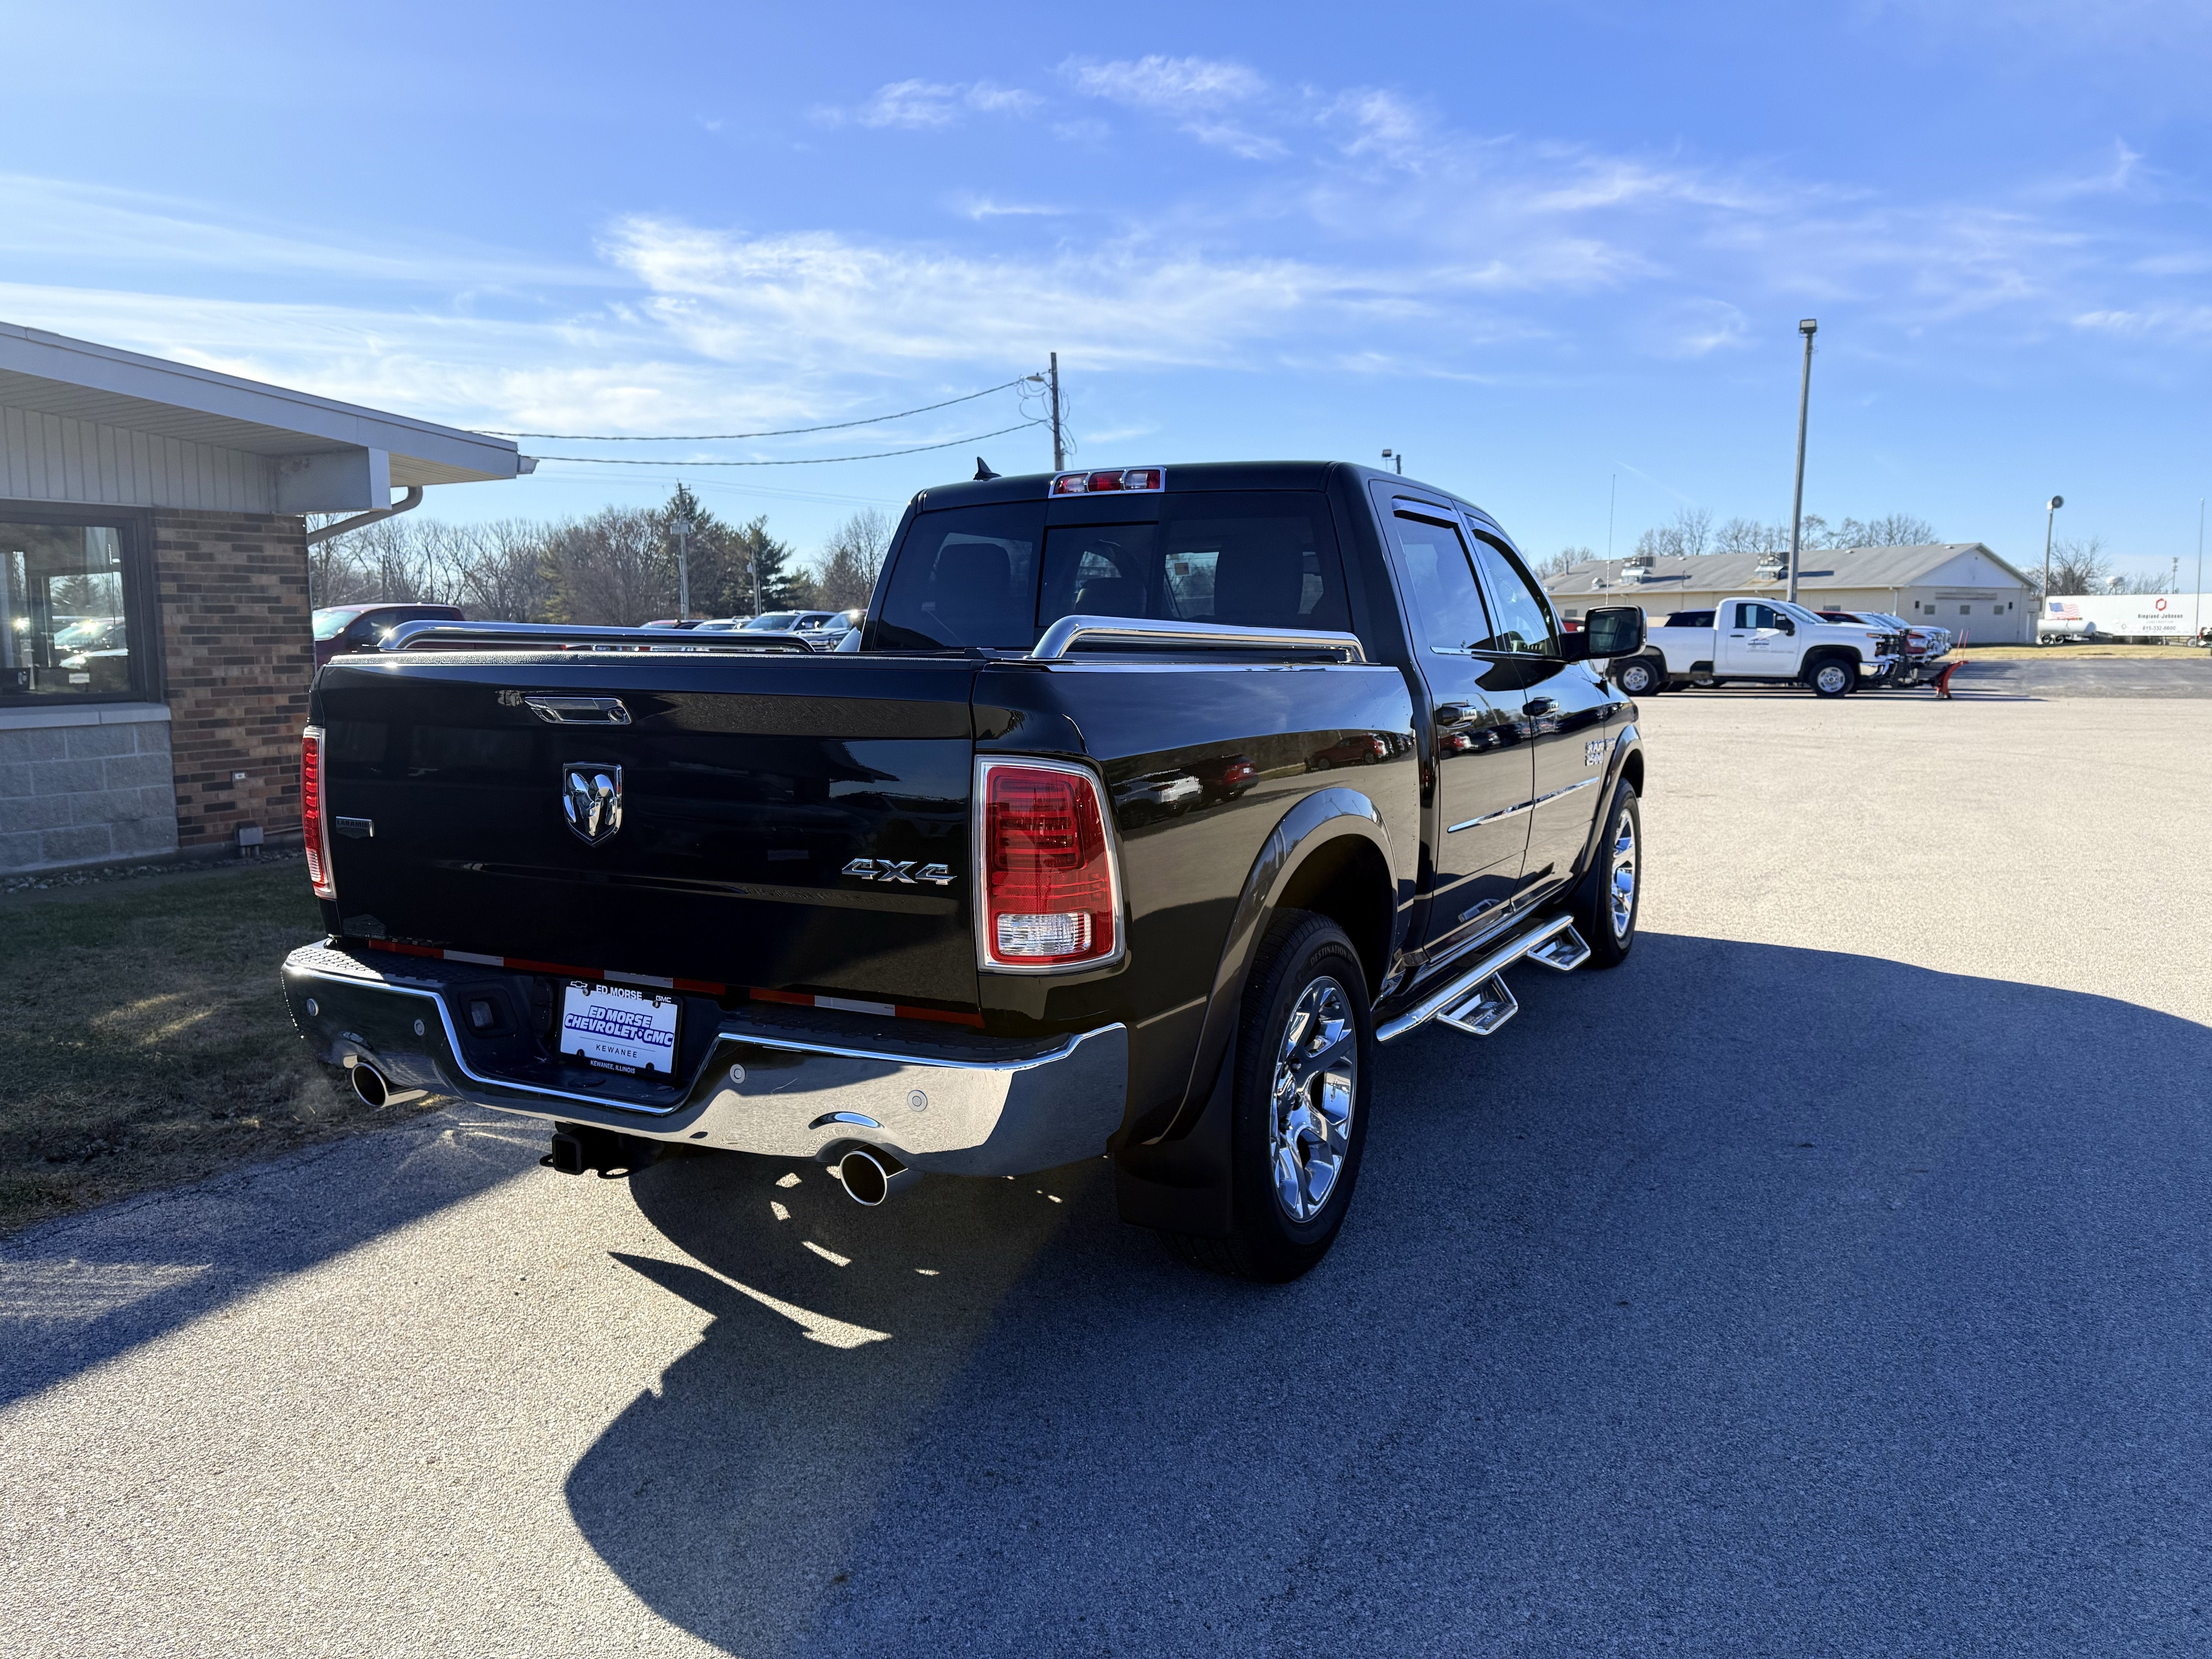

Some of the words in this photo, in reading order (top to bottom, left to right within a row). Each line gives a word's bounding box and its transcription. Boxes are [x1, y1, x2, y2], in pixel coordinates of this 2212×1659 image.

[1311, 945, 1347, 966] DESTINATION
[596, 984, 608, 994] ED
[610, 987, 642, 1001] MORSE
[589, 1006, 607, 1018] ED
[606, 1009, 652, 1028] MORSE
[596, 1044, 637, 1058] KEWANEE
[591, 1060, 615, 1070] KEWANEE,
[615, 1065, 635, 1073] ILLINOIS
